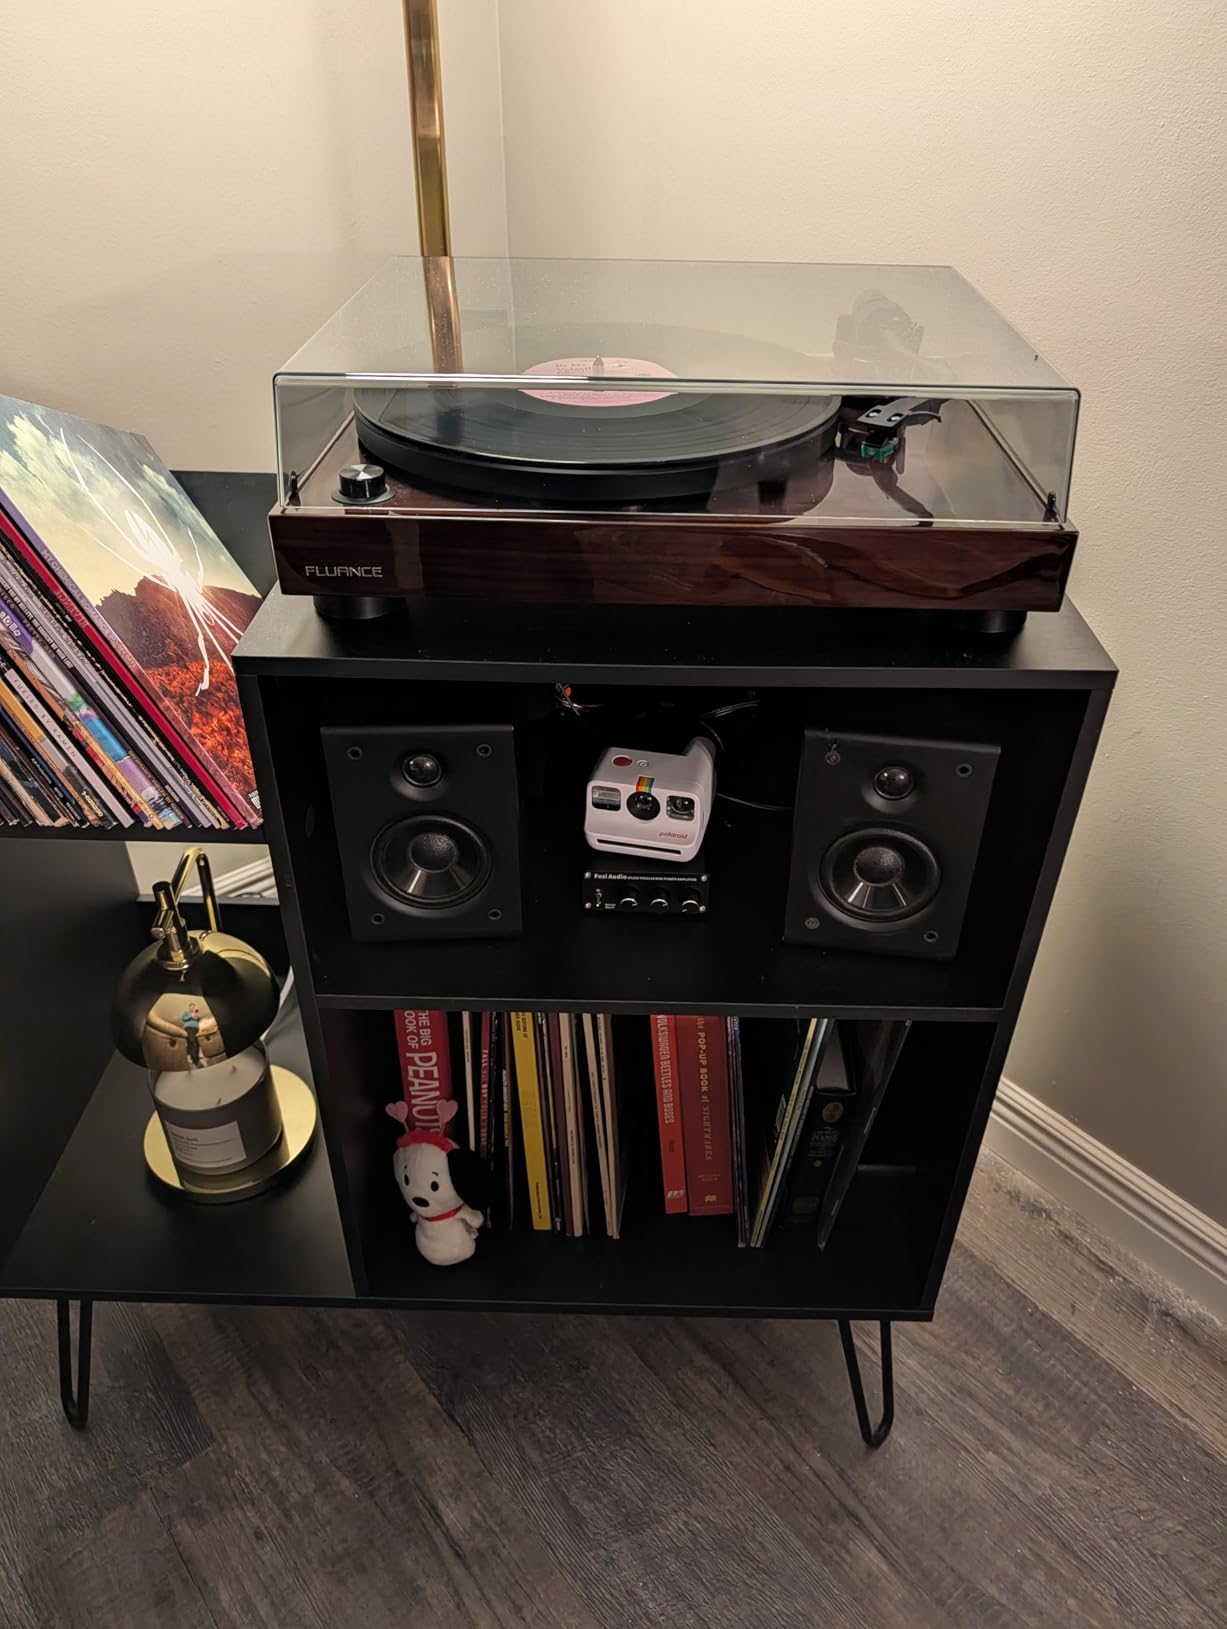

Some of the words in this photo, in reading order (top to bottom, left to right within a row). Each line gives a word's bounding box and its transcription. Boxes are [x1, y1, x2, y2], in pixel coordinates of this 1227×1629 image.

[304, 565, 383, 578] FLUANCE
[49, 560, 83, 600] CHEMICAL
[79, 598, 110, 634] ROMANCE
[12, 678, 39, 710] FUELED
[40, 713, 50, 724] BY
[51, 727, 77, 758] RAMEN
[659, 831, 688, 840] polaroid
[608, 873, 628, 881] Audio
[404, 1010, 418, 1033] OOK
[418, 1010, 431, 1027] HE
[406, 1035, 419, 1049] OF
[419, 1028, 432, 1047] BIG
[700, 1067, 710, 1093] BOOK
[405, 1051, 442, 1132] PEANUT
